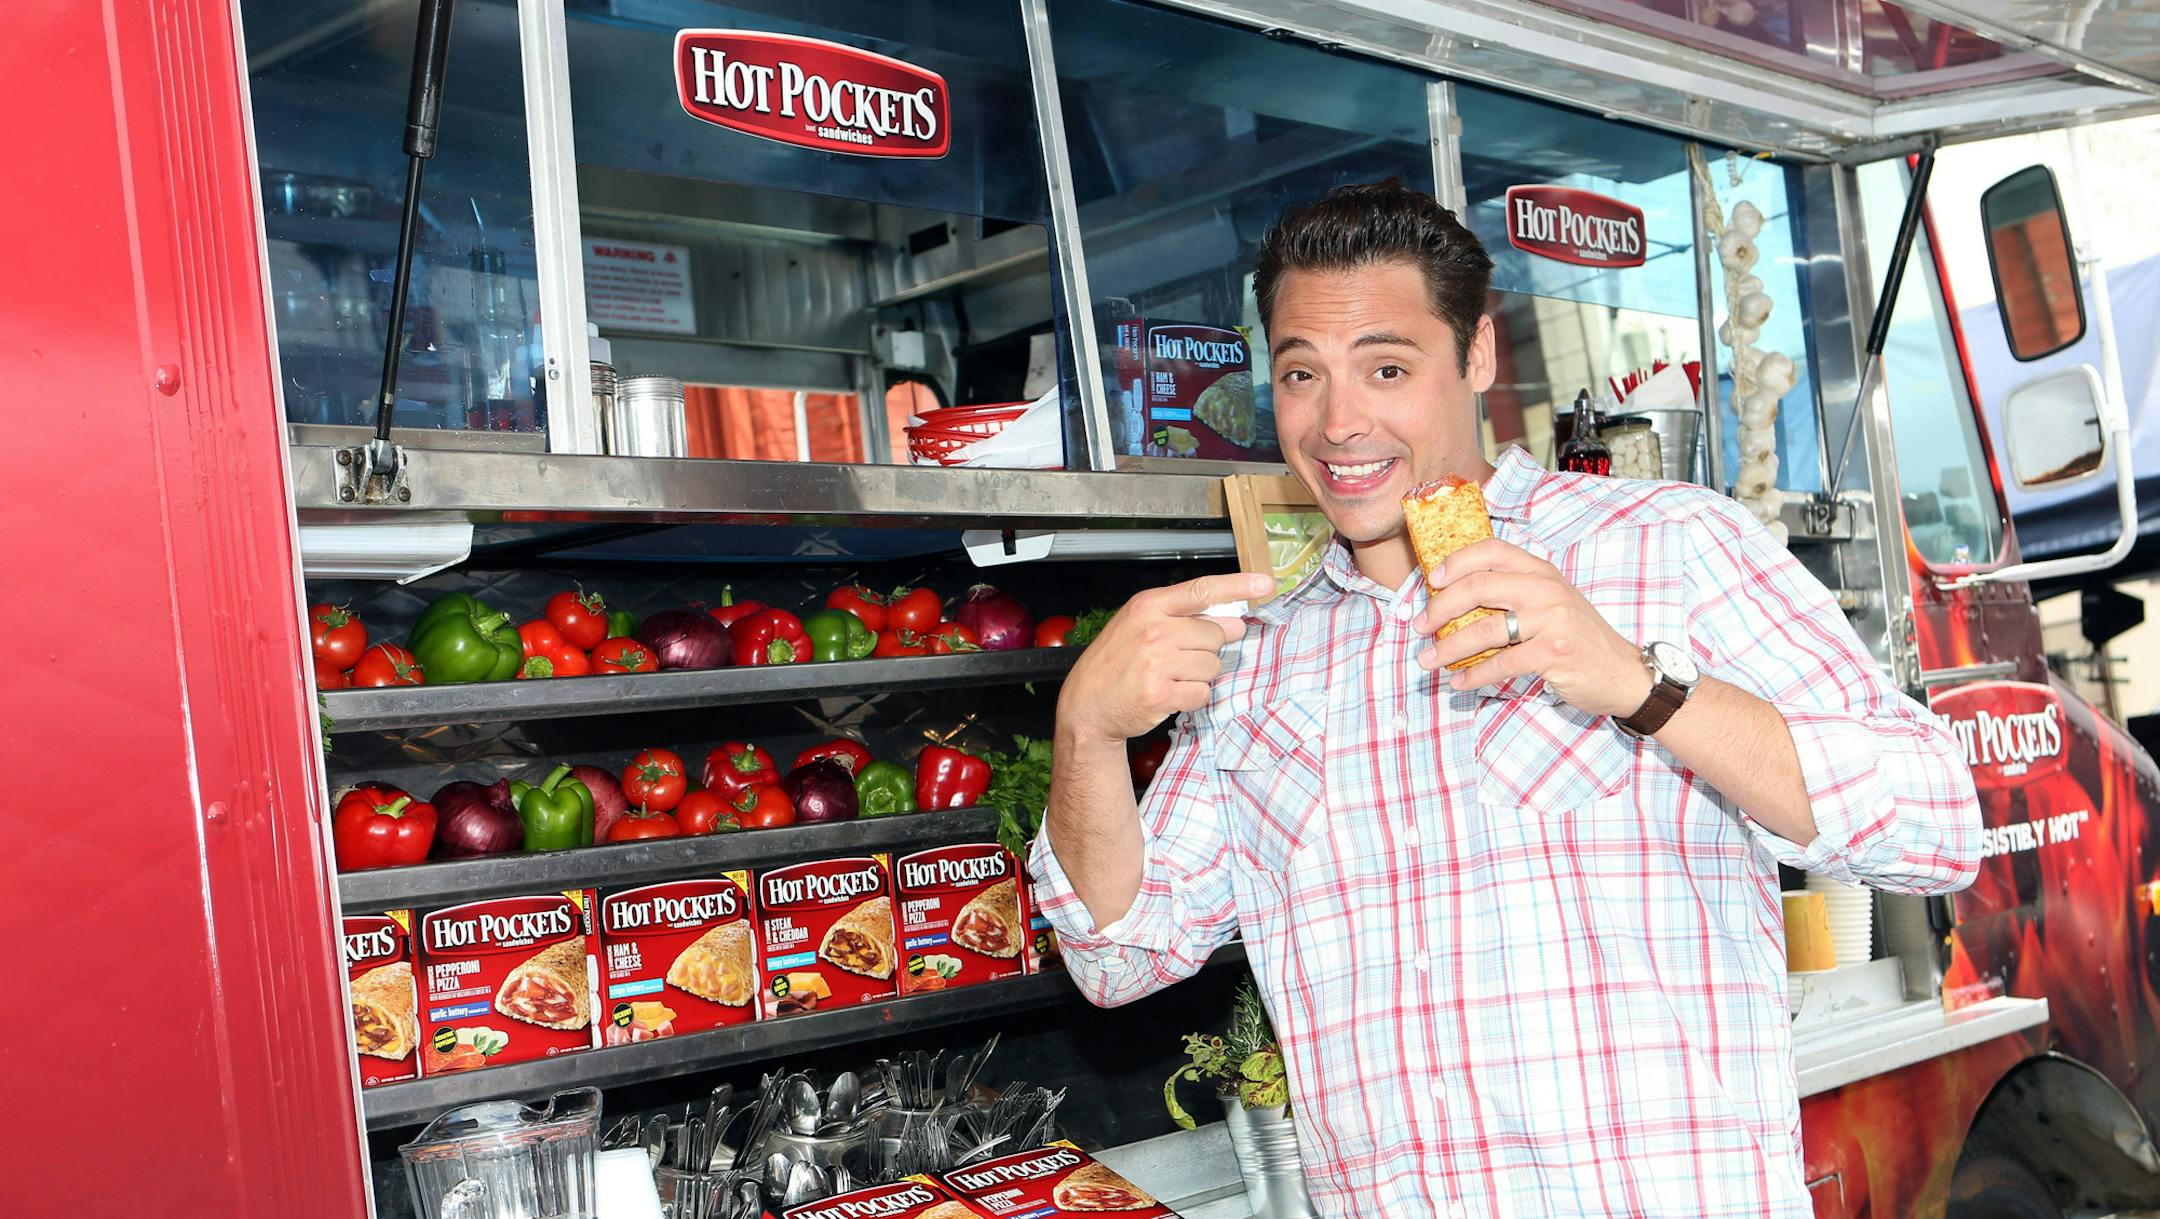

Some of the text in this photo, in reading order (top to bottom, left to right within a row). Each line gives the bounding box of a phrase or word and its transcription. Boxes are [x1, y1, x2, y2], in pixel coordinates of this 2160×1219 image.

[691, 46, 938, 141] HOT POCKETS
[817, 125, 874, 145] sandwiches
[1514, 197, 1642, 256] HOT POCKETS
[1154, 334, 1185, 359] HOT
[1184, 336, 1245, 365] POCKETS
[1156, 383, 1176, 396] CHEESE
[1938, 703, 2062, 766] OT POCKETS
[904, 850, 1006, 888] HOT POCKETS
[767, 866, 879, 906] HOT POCKETS
[611, 887, 737, 929] HOT POCKETS
[907, 896, 941, 913] PEPPERONI
[432, 903, 572, 949] HOT POCKETS
[770, 916, 793, 932] STEAK
[908, 911, 927, 925] PIZZA
[771, 931, 779, 944] &
[779, 926, 809, 943] CHEDDAR
[613, 942, 630, 958] HAM
[631, 941, 639, 955] &
[614, 953, 643, 970] CHEESE
[434, 959, 480, 978] PEPPERONI
[436, 975, 461, 992] PIZZA
[953, 1149, 1082, 1191] HOT POCKETS
[837, 1184, 935, 1217] POCKETS
